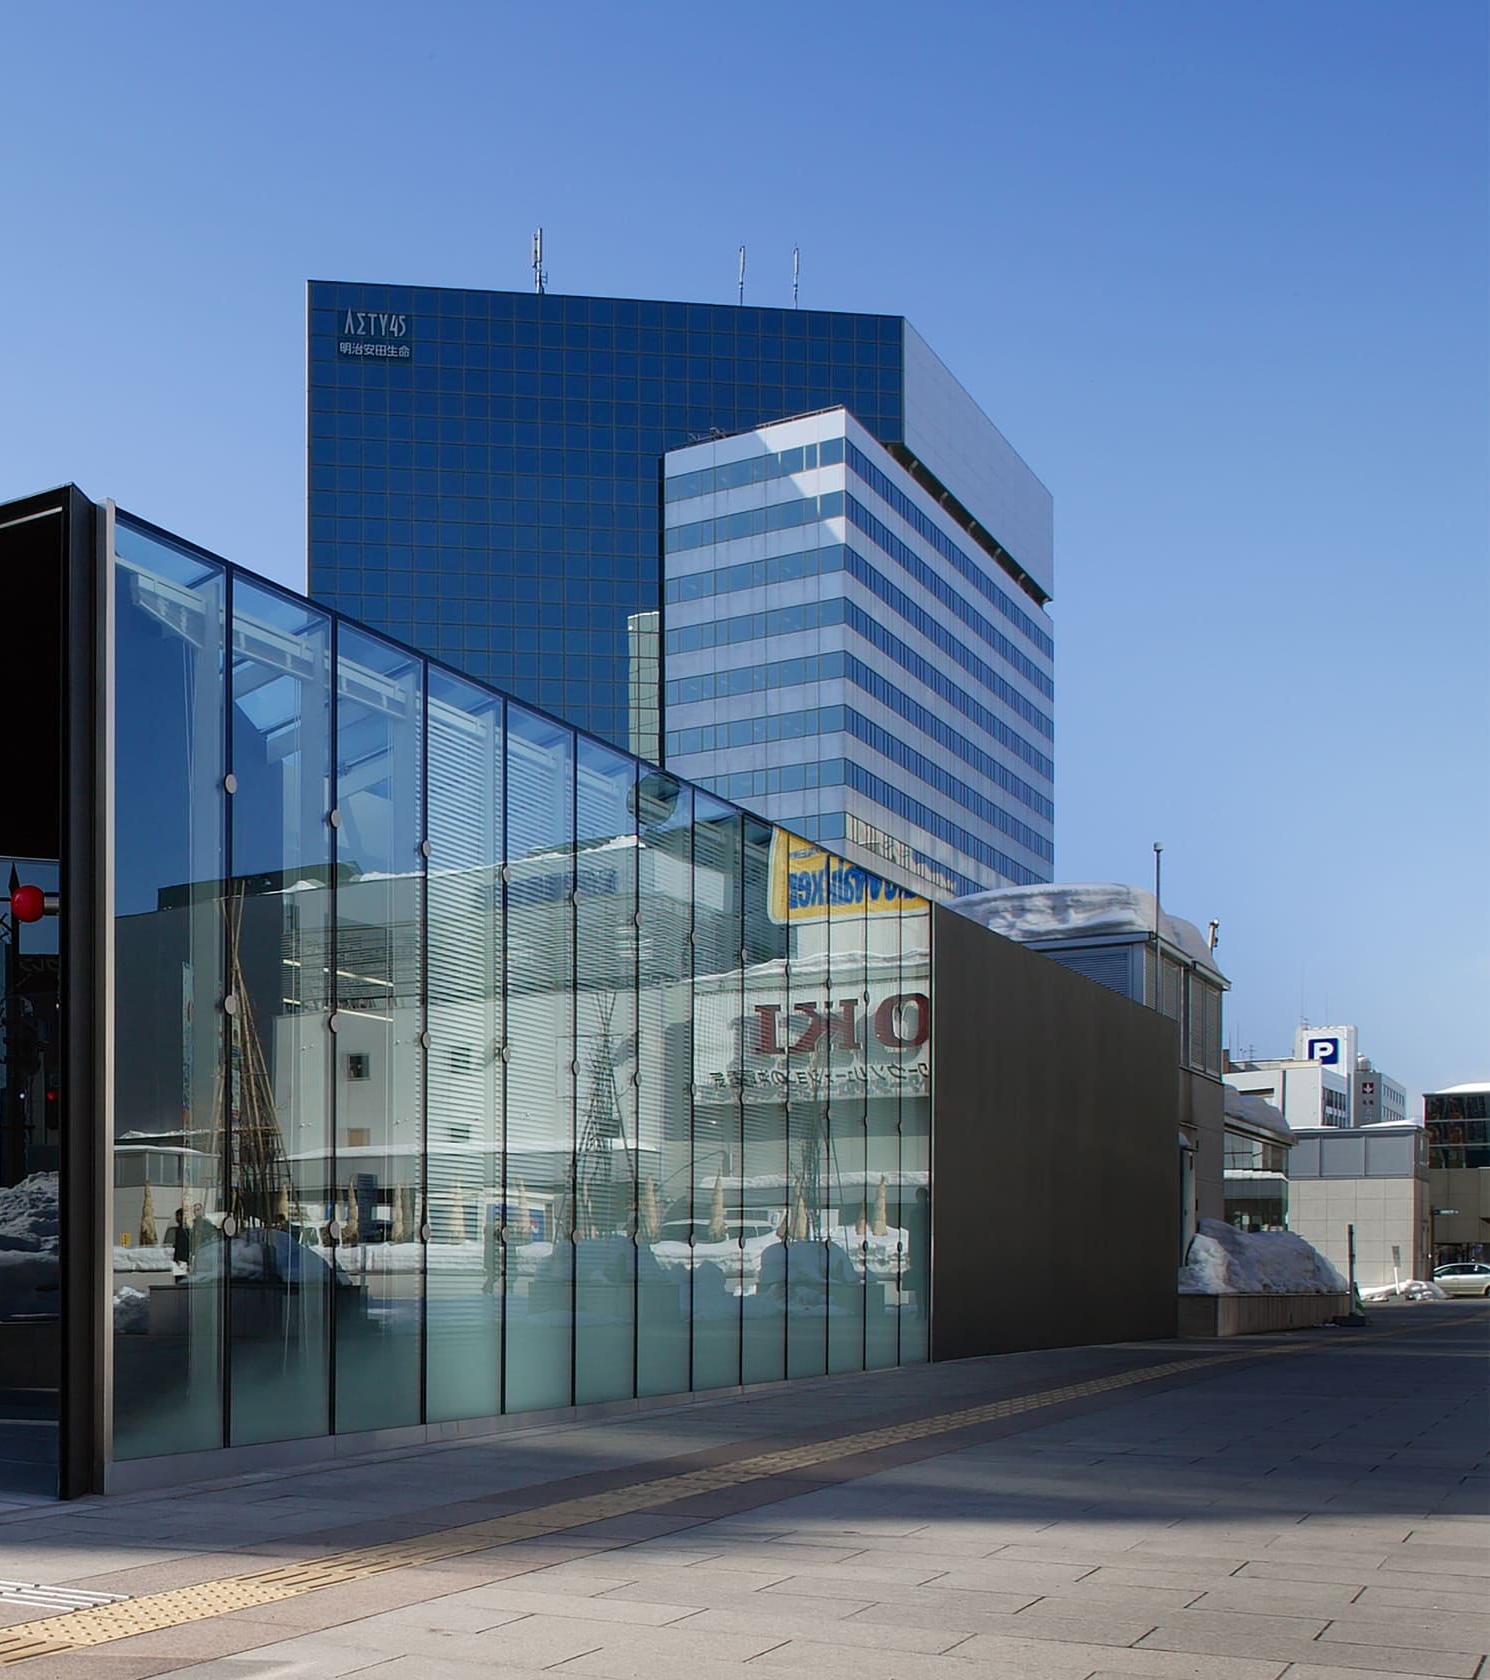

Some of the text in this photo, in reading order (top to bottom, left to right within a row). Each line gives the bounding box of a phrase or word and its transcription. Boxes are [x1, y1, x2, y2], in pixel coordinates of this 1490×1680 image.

[339, 342, 411, 358] 明治安田生命
[1314, 1042, 1334, 1060] P
